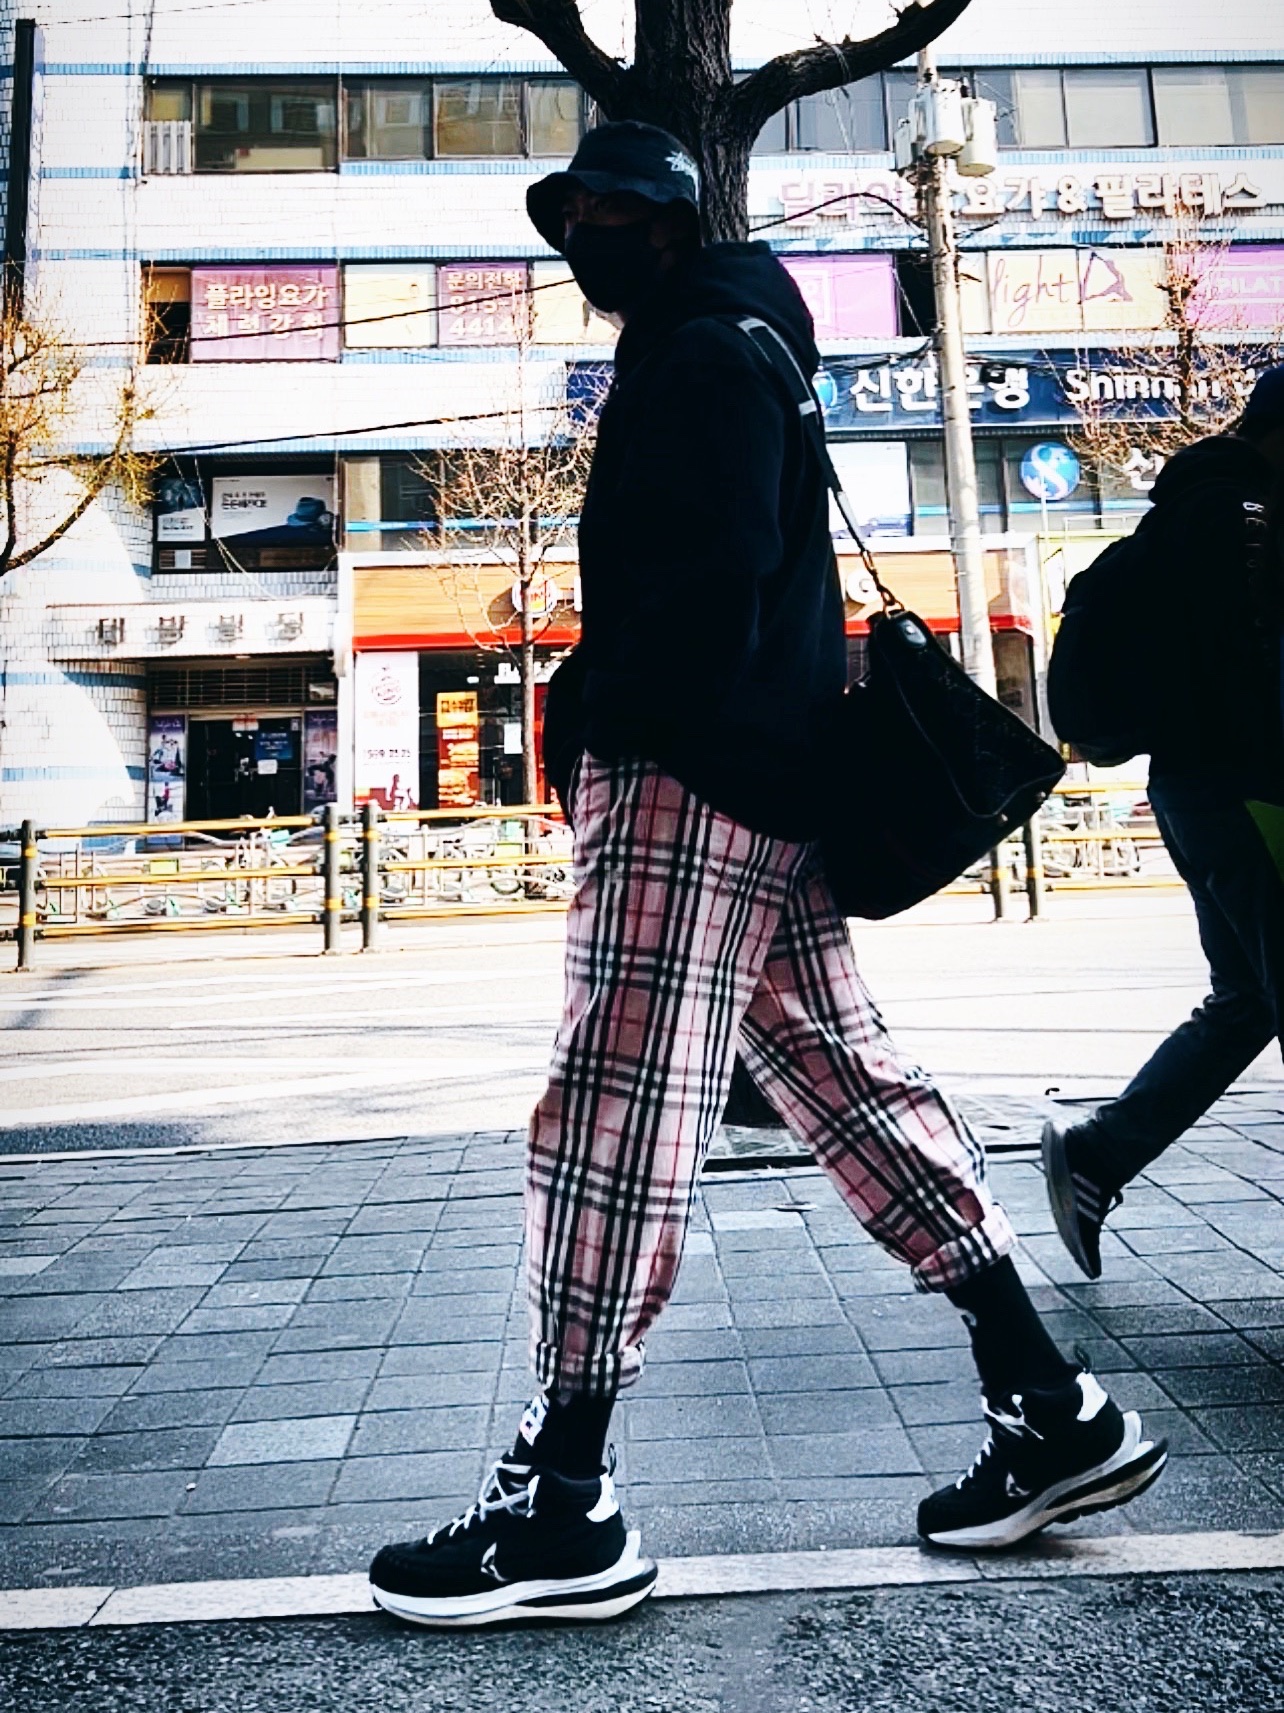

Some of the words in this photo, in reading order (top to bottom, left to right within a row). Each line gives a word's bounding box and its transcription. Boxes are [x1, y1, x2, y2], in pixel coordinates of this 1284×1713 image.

[960, 176, 1046, 220] 요가
[1057, 175, 1088, 213] &
[1095, 173, 1267, 219] 필라테스
[446, 271, 523, 291] 문의전화
[204, 283, 331, 311] 플라잉요가
